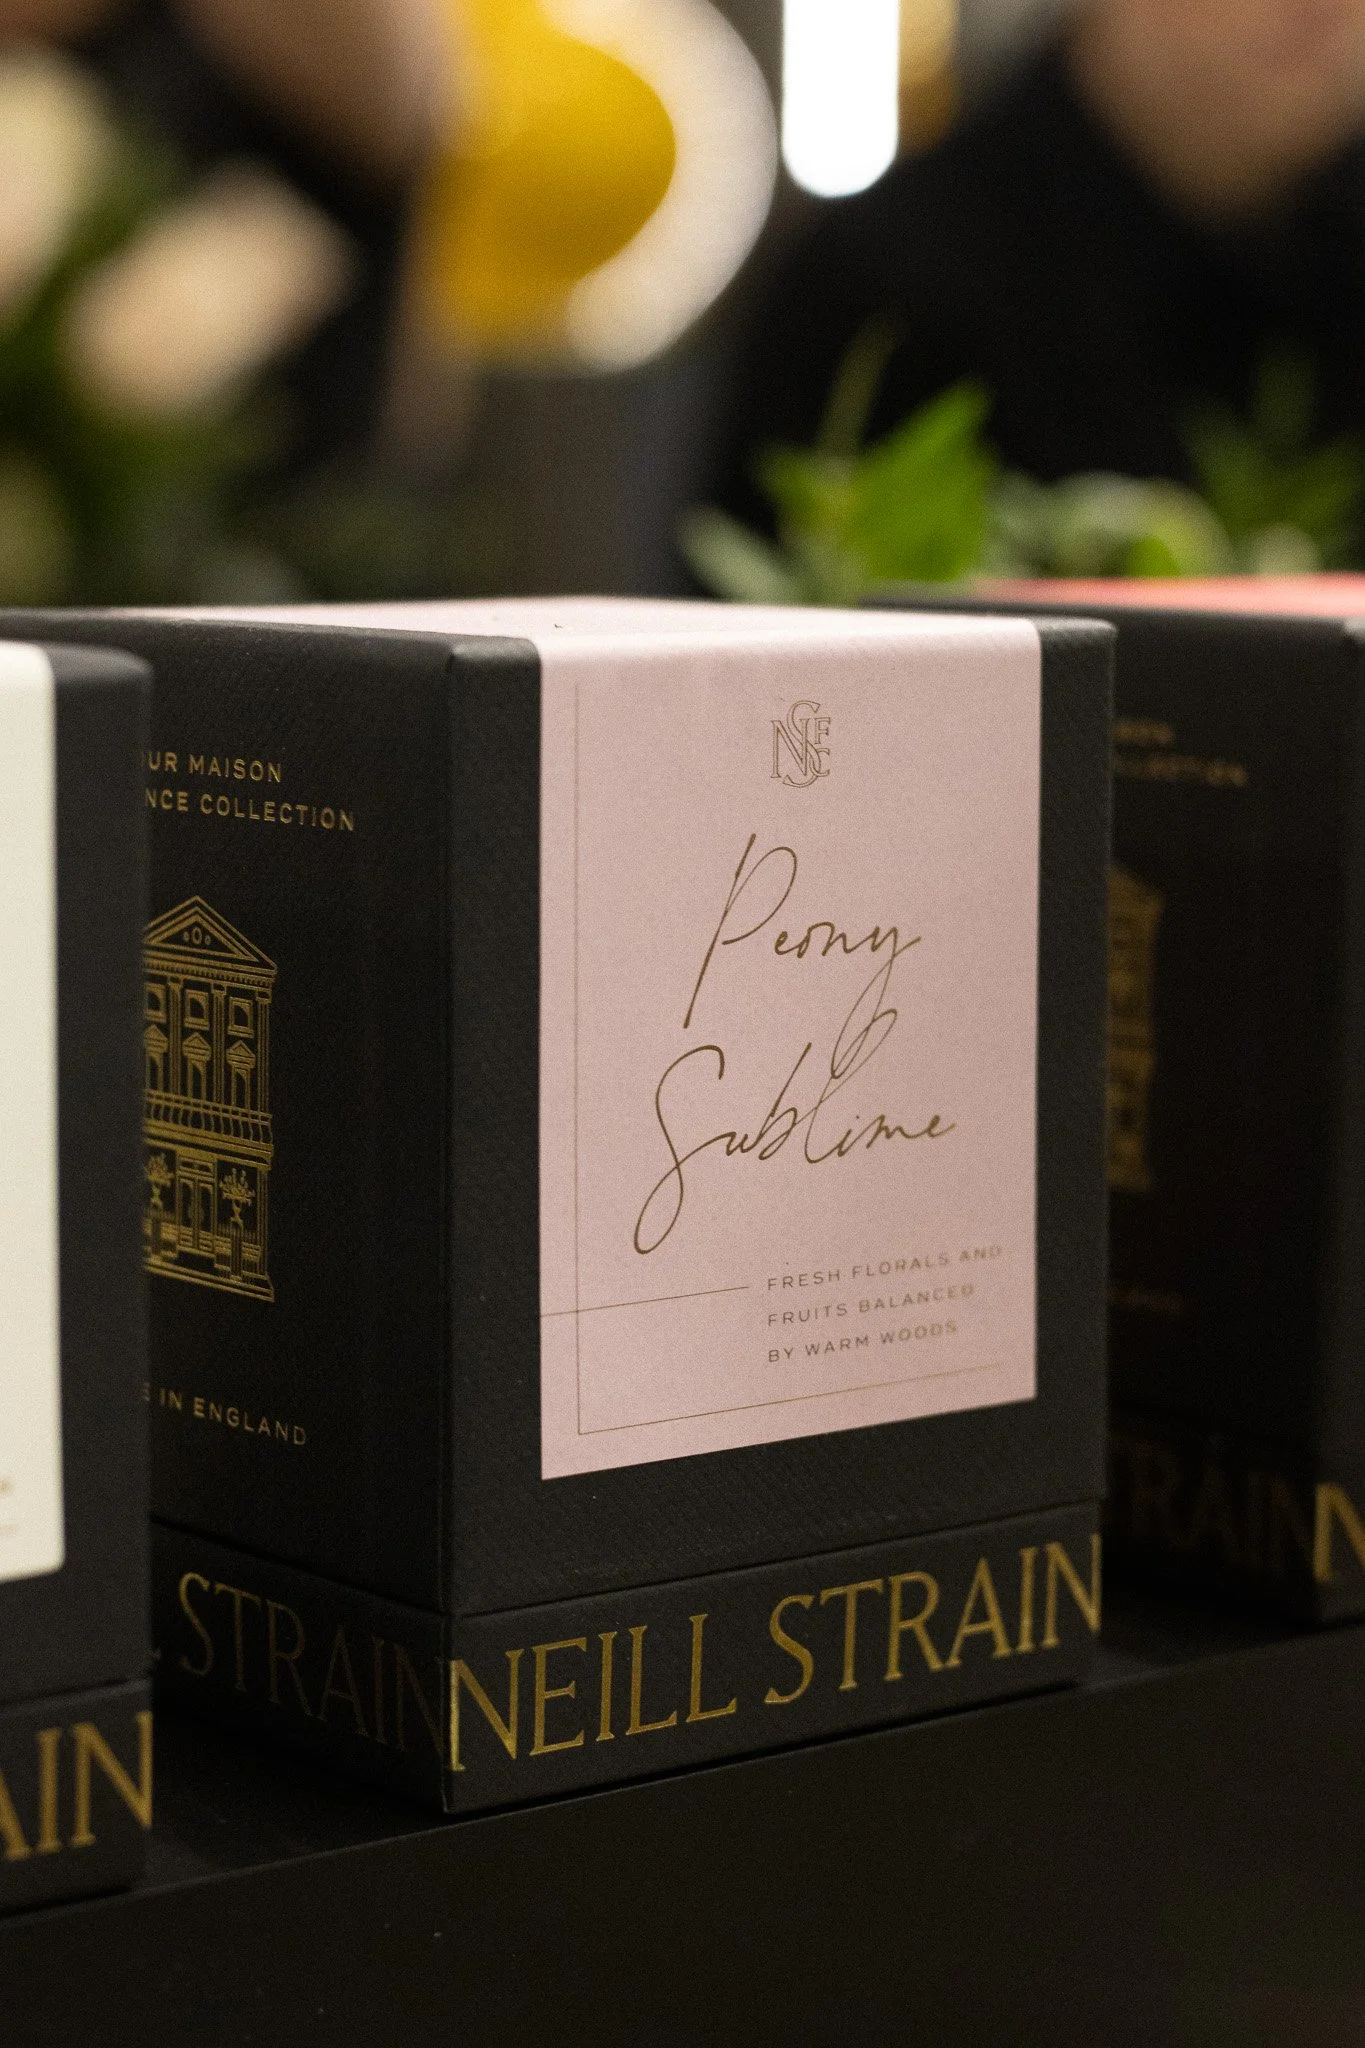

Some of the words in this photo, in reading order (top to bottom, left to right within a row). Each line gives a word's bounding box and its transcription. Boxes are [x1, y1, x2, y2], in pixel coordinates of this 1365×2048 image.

[188, 752, 282, 784] MAISON
[200, 793, 356, 832] COLLECTION
[683, 832, 923, 1079] Peony
[633, 1008, 957, 1255] Sublime
[767, 1269, 841, 1291] FRESH
[851, 1250, 950, 1279] FLORALS
[958, 1244, 1002, 1263] AND
[767, 1302, 848, 1327] FRUITS
[858, 1283, 975, 1313] BALANCED
[767, 1347, 794, 1363] BY
[805, 1334, 870, 1357] WARM
[879, 1320, 958, 1345] WOODS
[159, 1387, 183, 1412] IN
[192, 1396, 307, 1446] ENGLAND
[448, 1612, 738, 1772] NEILL
[762, 1533, 1101, 1705] STRAIN
